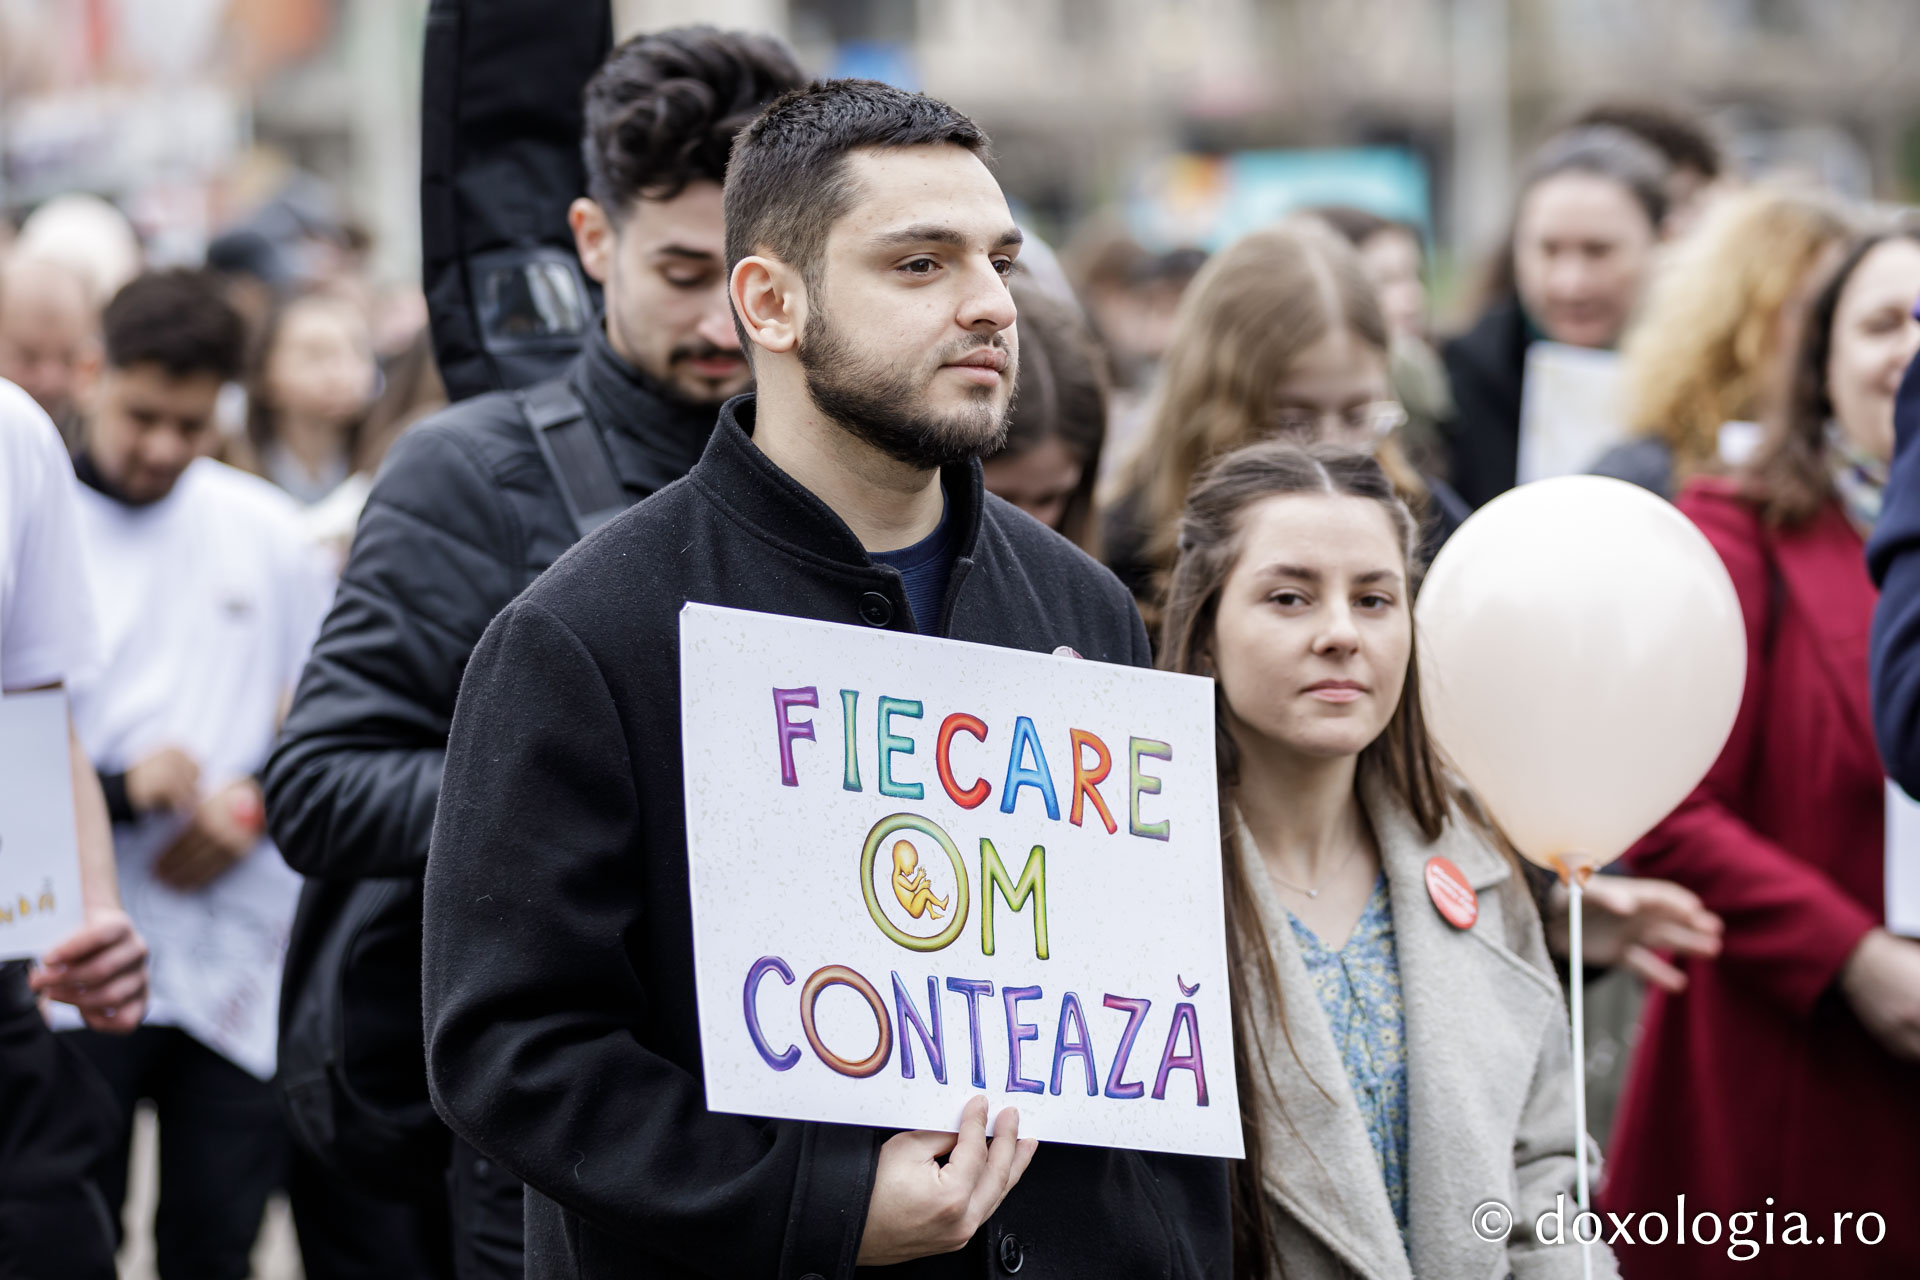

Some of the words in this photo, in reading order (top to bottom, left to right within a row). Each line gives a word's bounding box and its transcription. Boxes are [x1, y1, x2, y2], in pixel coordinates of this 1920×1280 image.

[772, 686, 1173, 842] FIECARE
[860, 812, 1050, 960] OM
[743, 955, 1210, 1107] CONTEAZĂ
